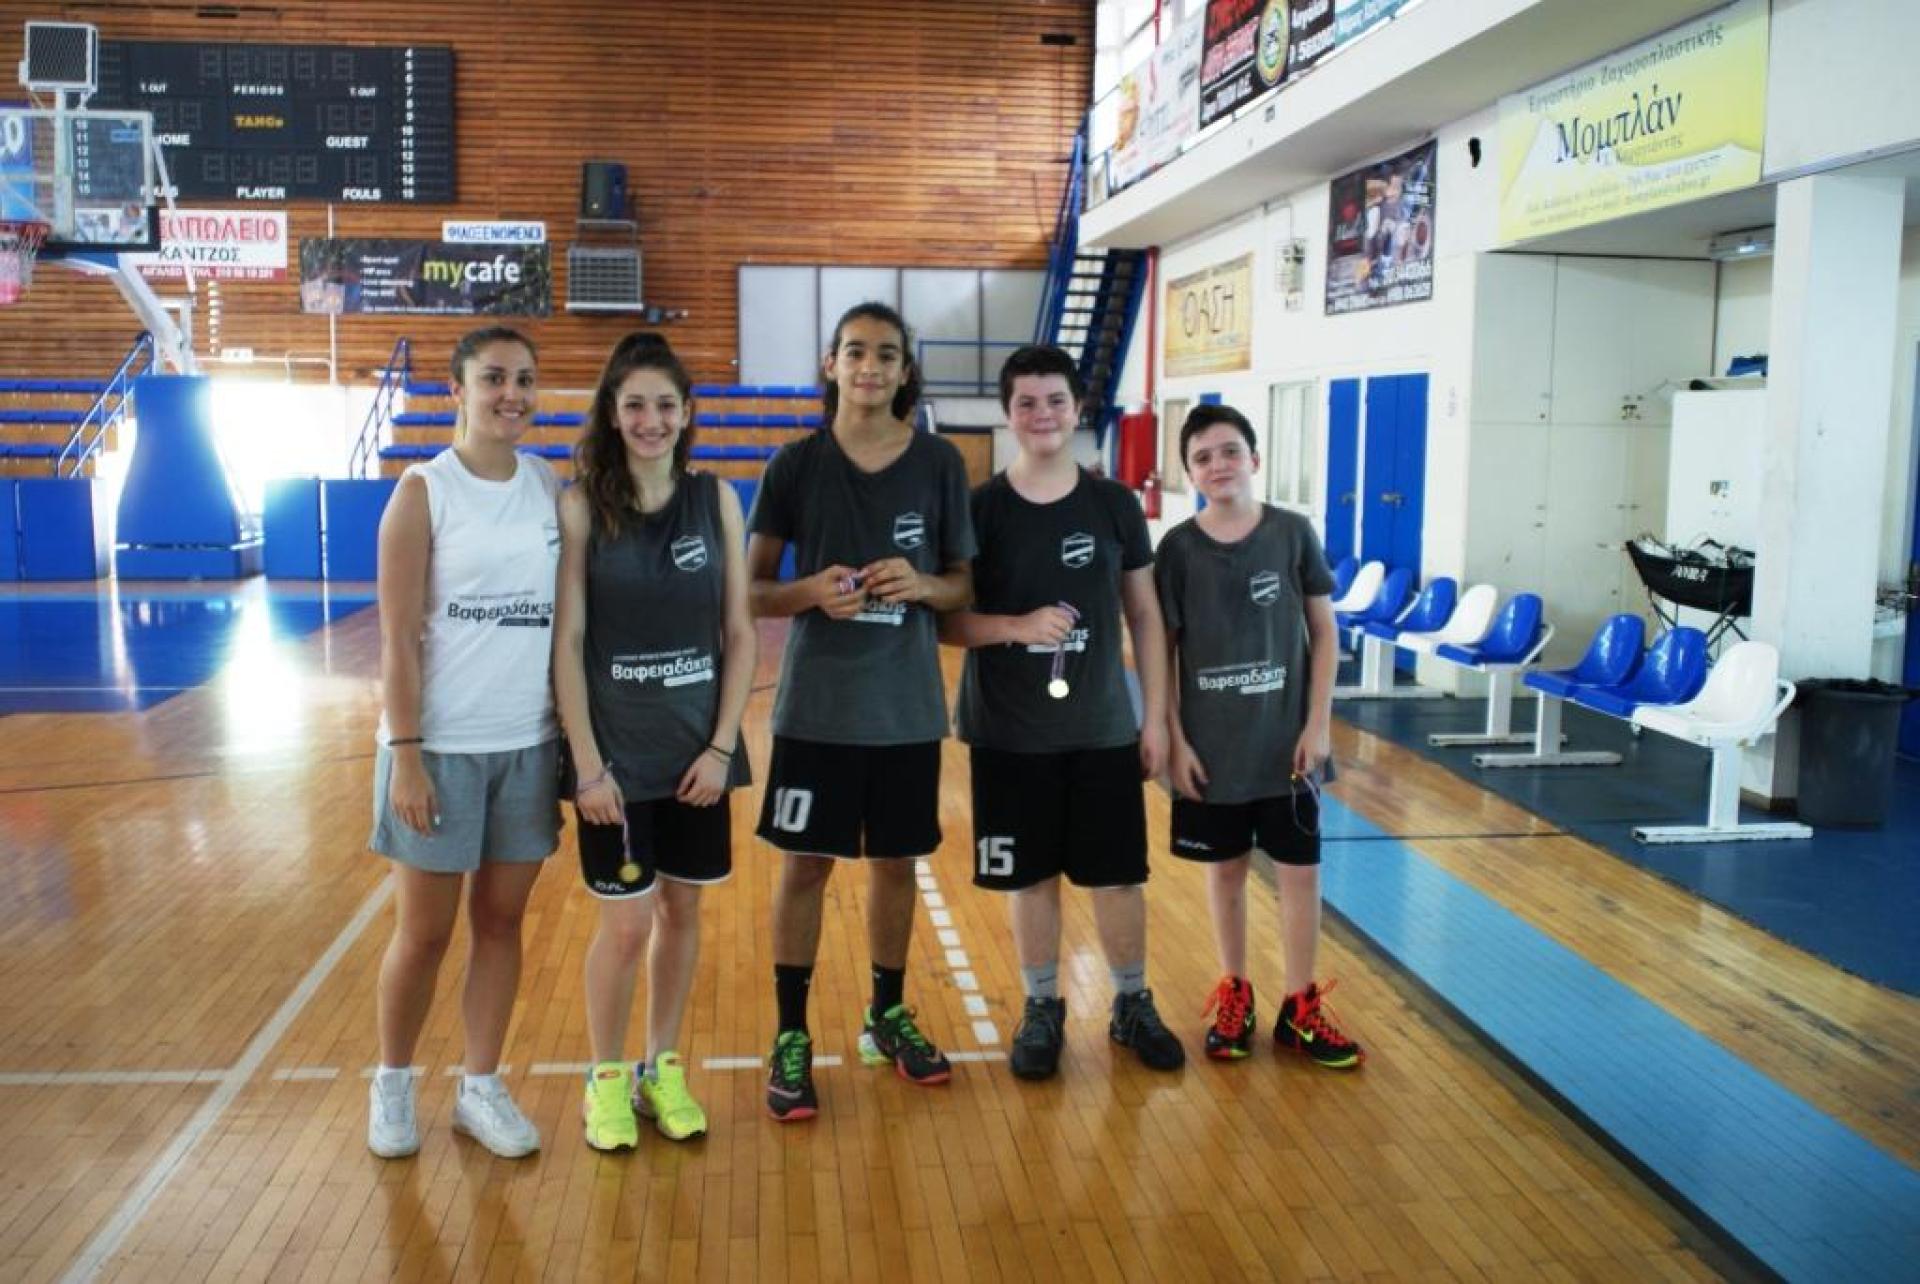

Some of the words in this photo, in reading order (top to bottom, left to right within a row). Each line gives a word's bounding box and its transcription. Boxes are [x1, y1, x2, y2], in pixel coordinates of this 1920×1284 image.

[1553, 83, 1683, 163] Μομπλάν
[325, 136, 369, 148] GUEST
[236, 187, 286, 199] PLAYER
[342, 188, 381, 200] FOULS
[423, 254, 521, 289] mycafe
[772, 786, 813, 833] 10
[977, 836, 1015, 877] 15
